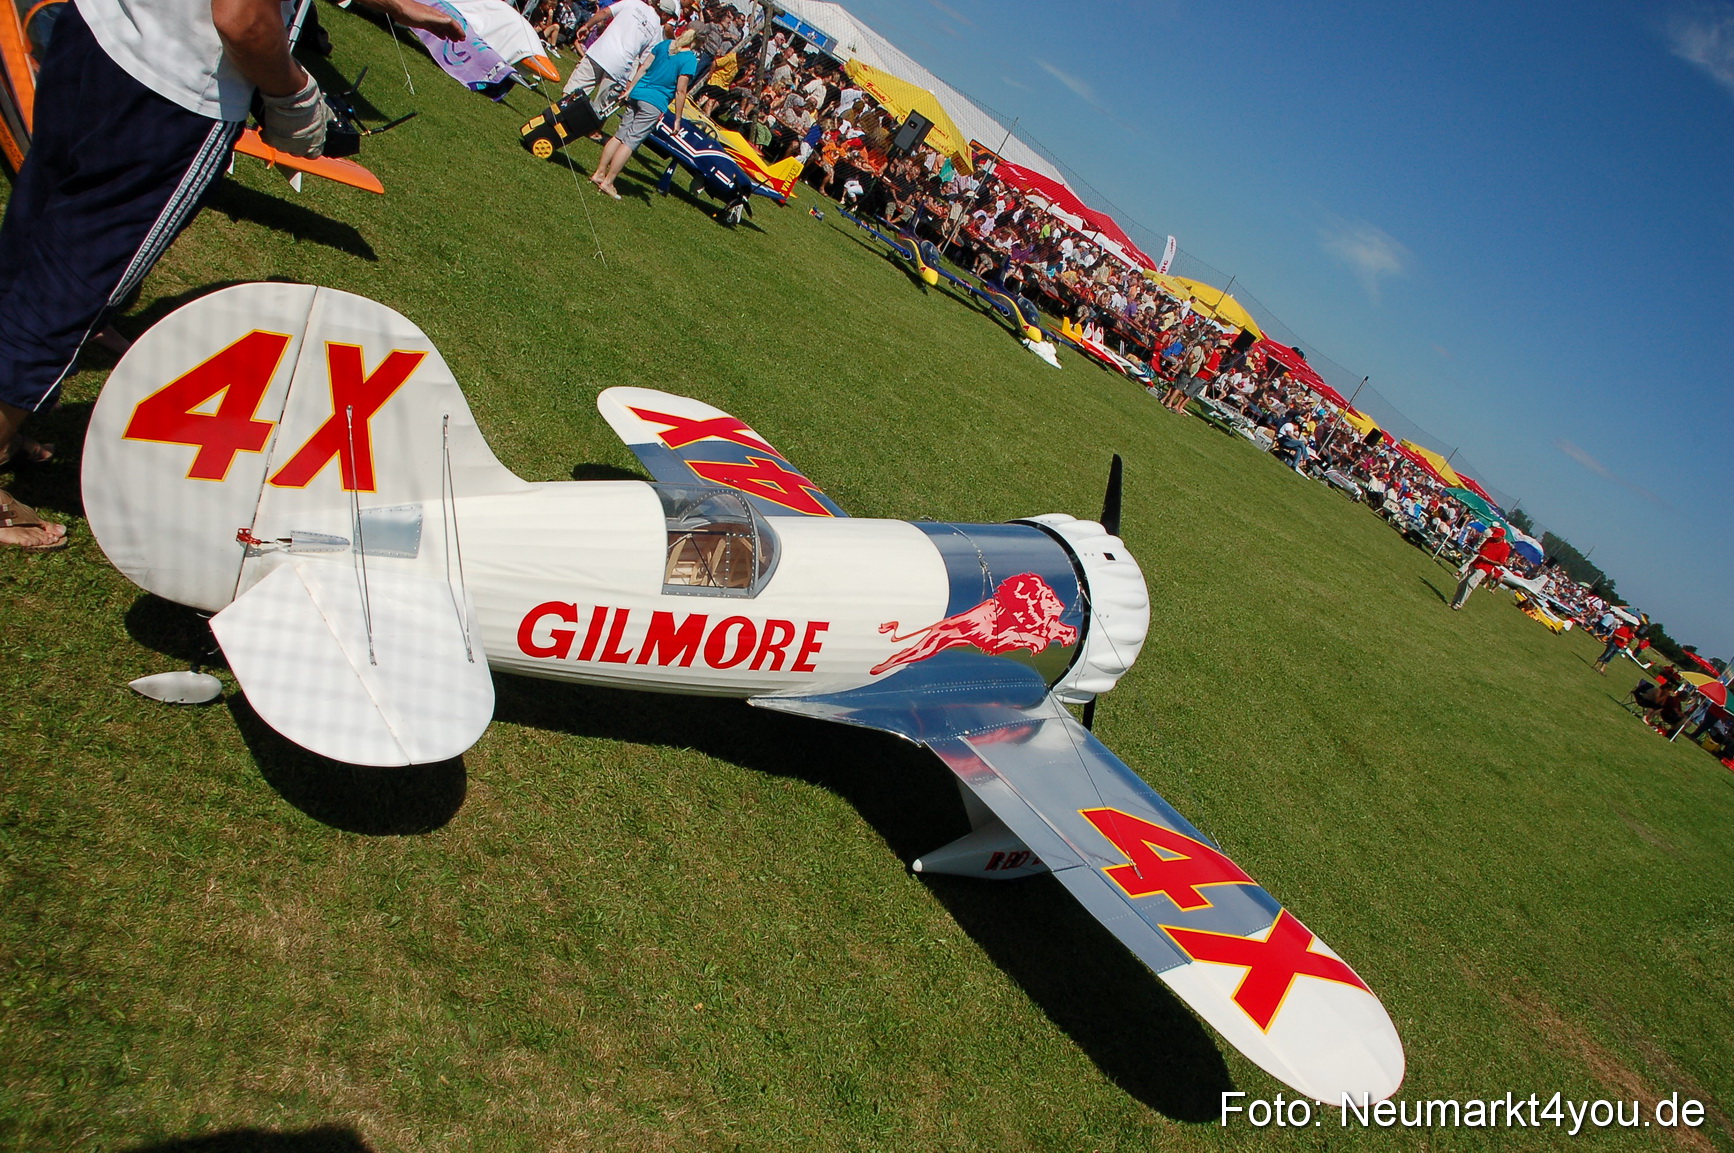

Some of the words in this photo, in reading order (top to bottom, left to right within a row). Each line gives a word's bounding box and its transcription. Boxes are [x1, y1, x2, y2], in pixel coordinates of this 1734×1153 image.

[122, 329, 428, 493] 4X
[516, 600, 830, 673] GILMORE
[1077, 807, 1379, 1035] 4X
